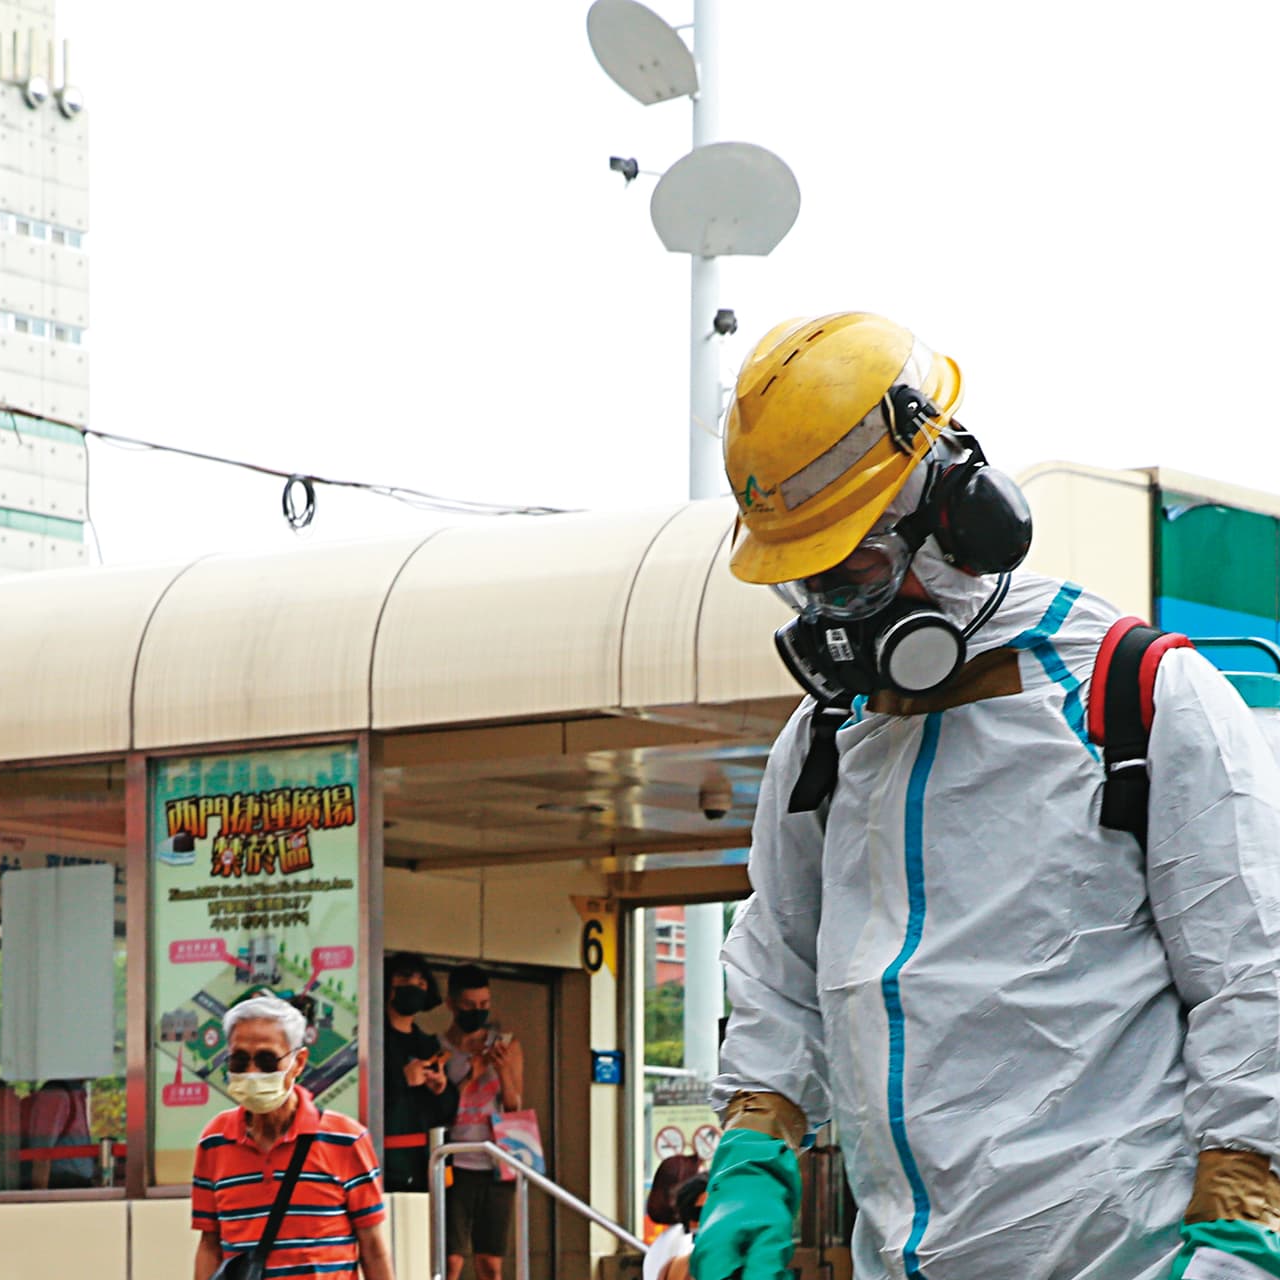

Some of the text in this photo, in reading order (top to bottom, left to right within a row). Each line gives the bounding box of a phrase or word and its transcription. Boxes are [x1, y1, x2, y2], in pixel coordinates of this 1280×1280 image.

[166, 783, 355, 839] 西門捷運廣場
[583, 919, 604, 972] 6
